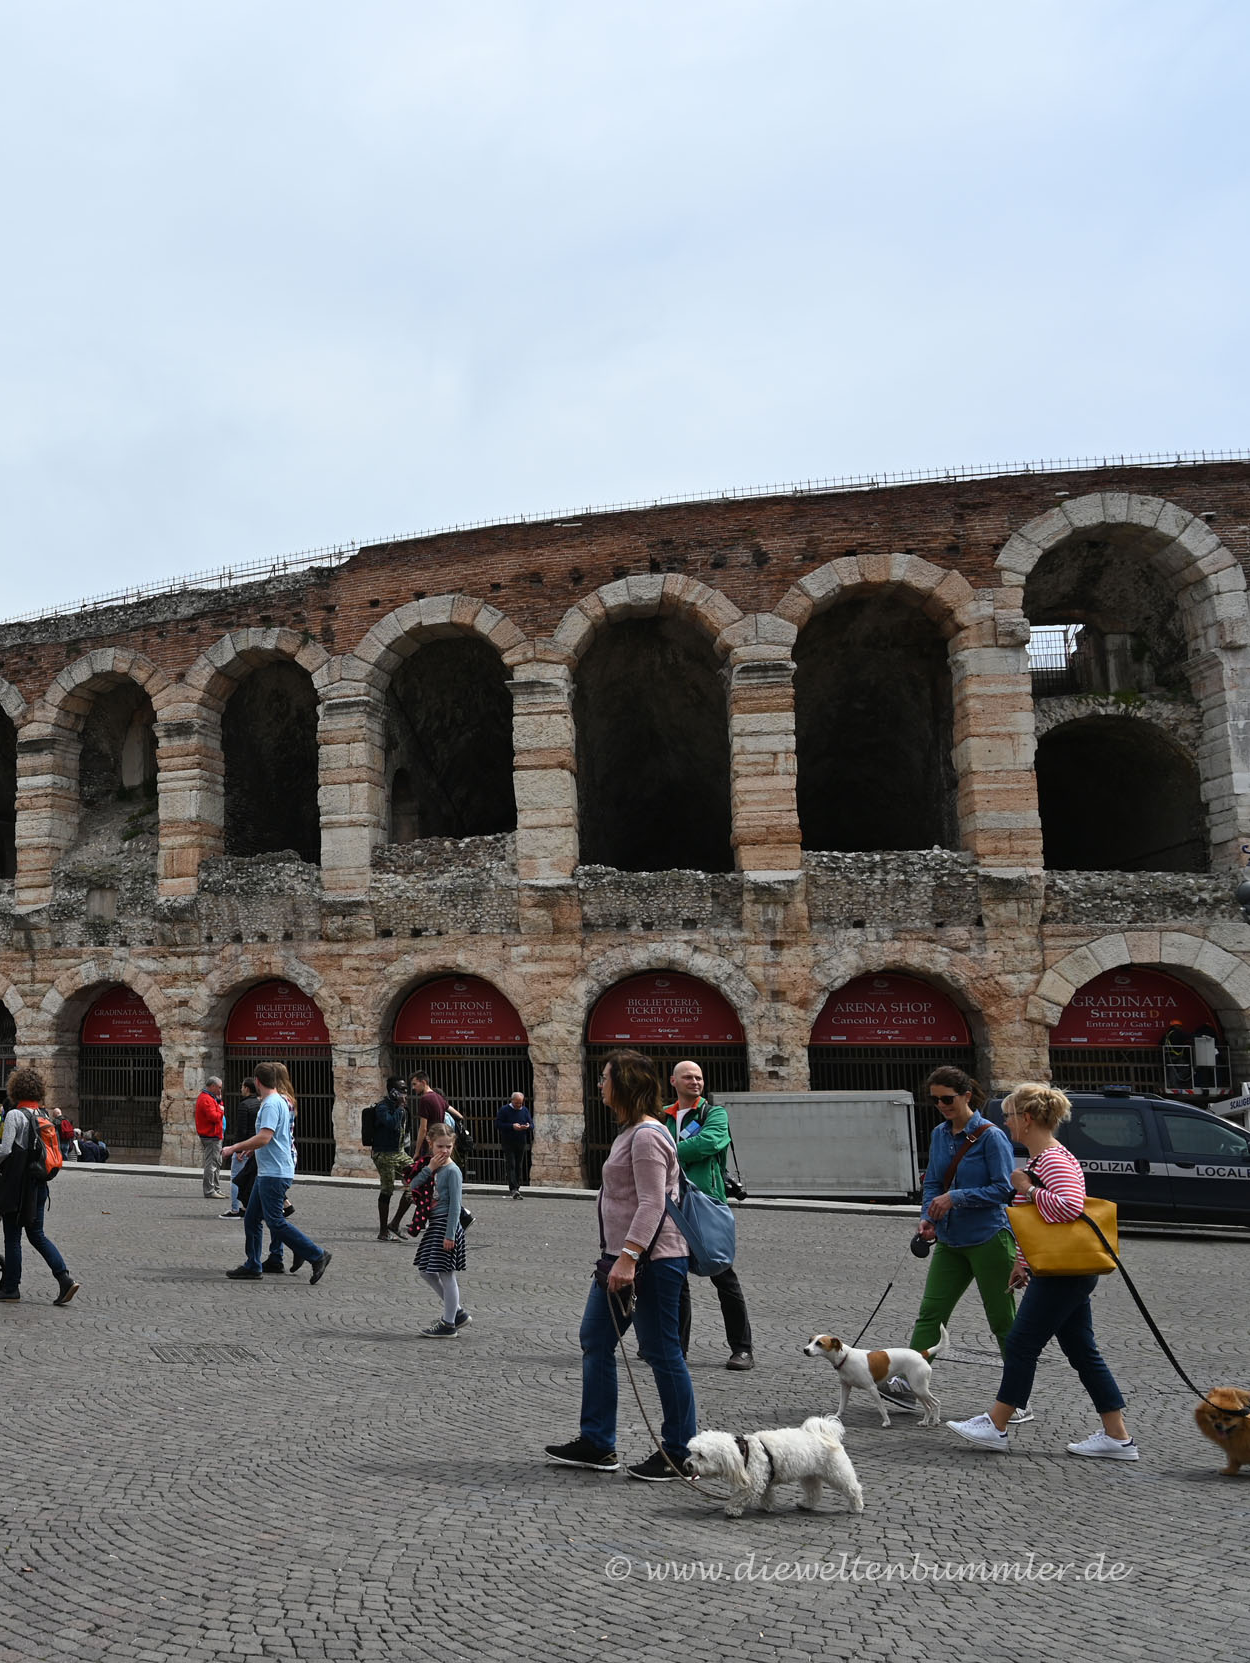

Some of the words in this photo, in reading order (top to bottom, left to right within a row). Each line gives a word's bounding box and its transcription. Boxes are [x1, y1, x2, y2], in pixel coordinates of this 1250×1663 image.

[430, 1001, 493, 1010] POLTRONE
[628, 999, 700, 1007] BIGLIETTERIA
[1071, 995, 1178, 1007] GRADINATA
[256, 1004, 312, 1012] BIGLIETTERIA
[625, 1007, 662, 1015] TICKET
[665, 1007, 703, 1015] OFFICE
[834, 1002, 887, 1013] ARENA
[890, 1002, 932, 1013] SHOP
[94, 1008, 138, 1017] GRADINATA
[1090, 1009, 1147, 1019] SETTORE
[1150, 1010, 1160, 1018] D
[831, 1016, 879, 1025] Cancello
[892, 1016, 918, 1025] Gate
[921, 1016, 936, 1025] 10
[1086, 1020, 1119, 1028] Entrata
[1130, 1020, 1152, 1028] Gate
[1154, 1020, 1165, 1028] 11
[1081, 1161, 1135, 1173] POLIZIA
[1196, 1167, 1250, 1178] LOCALE
